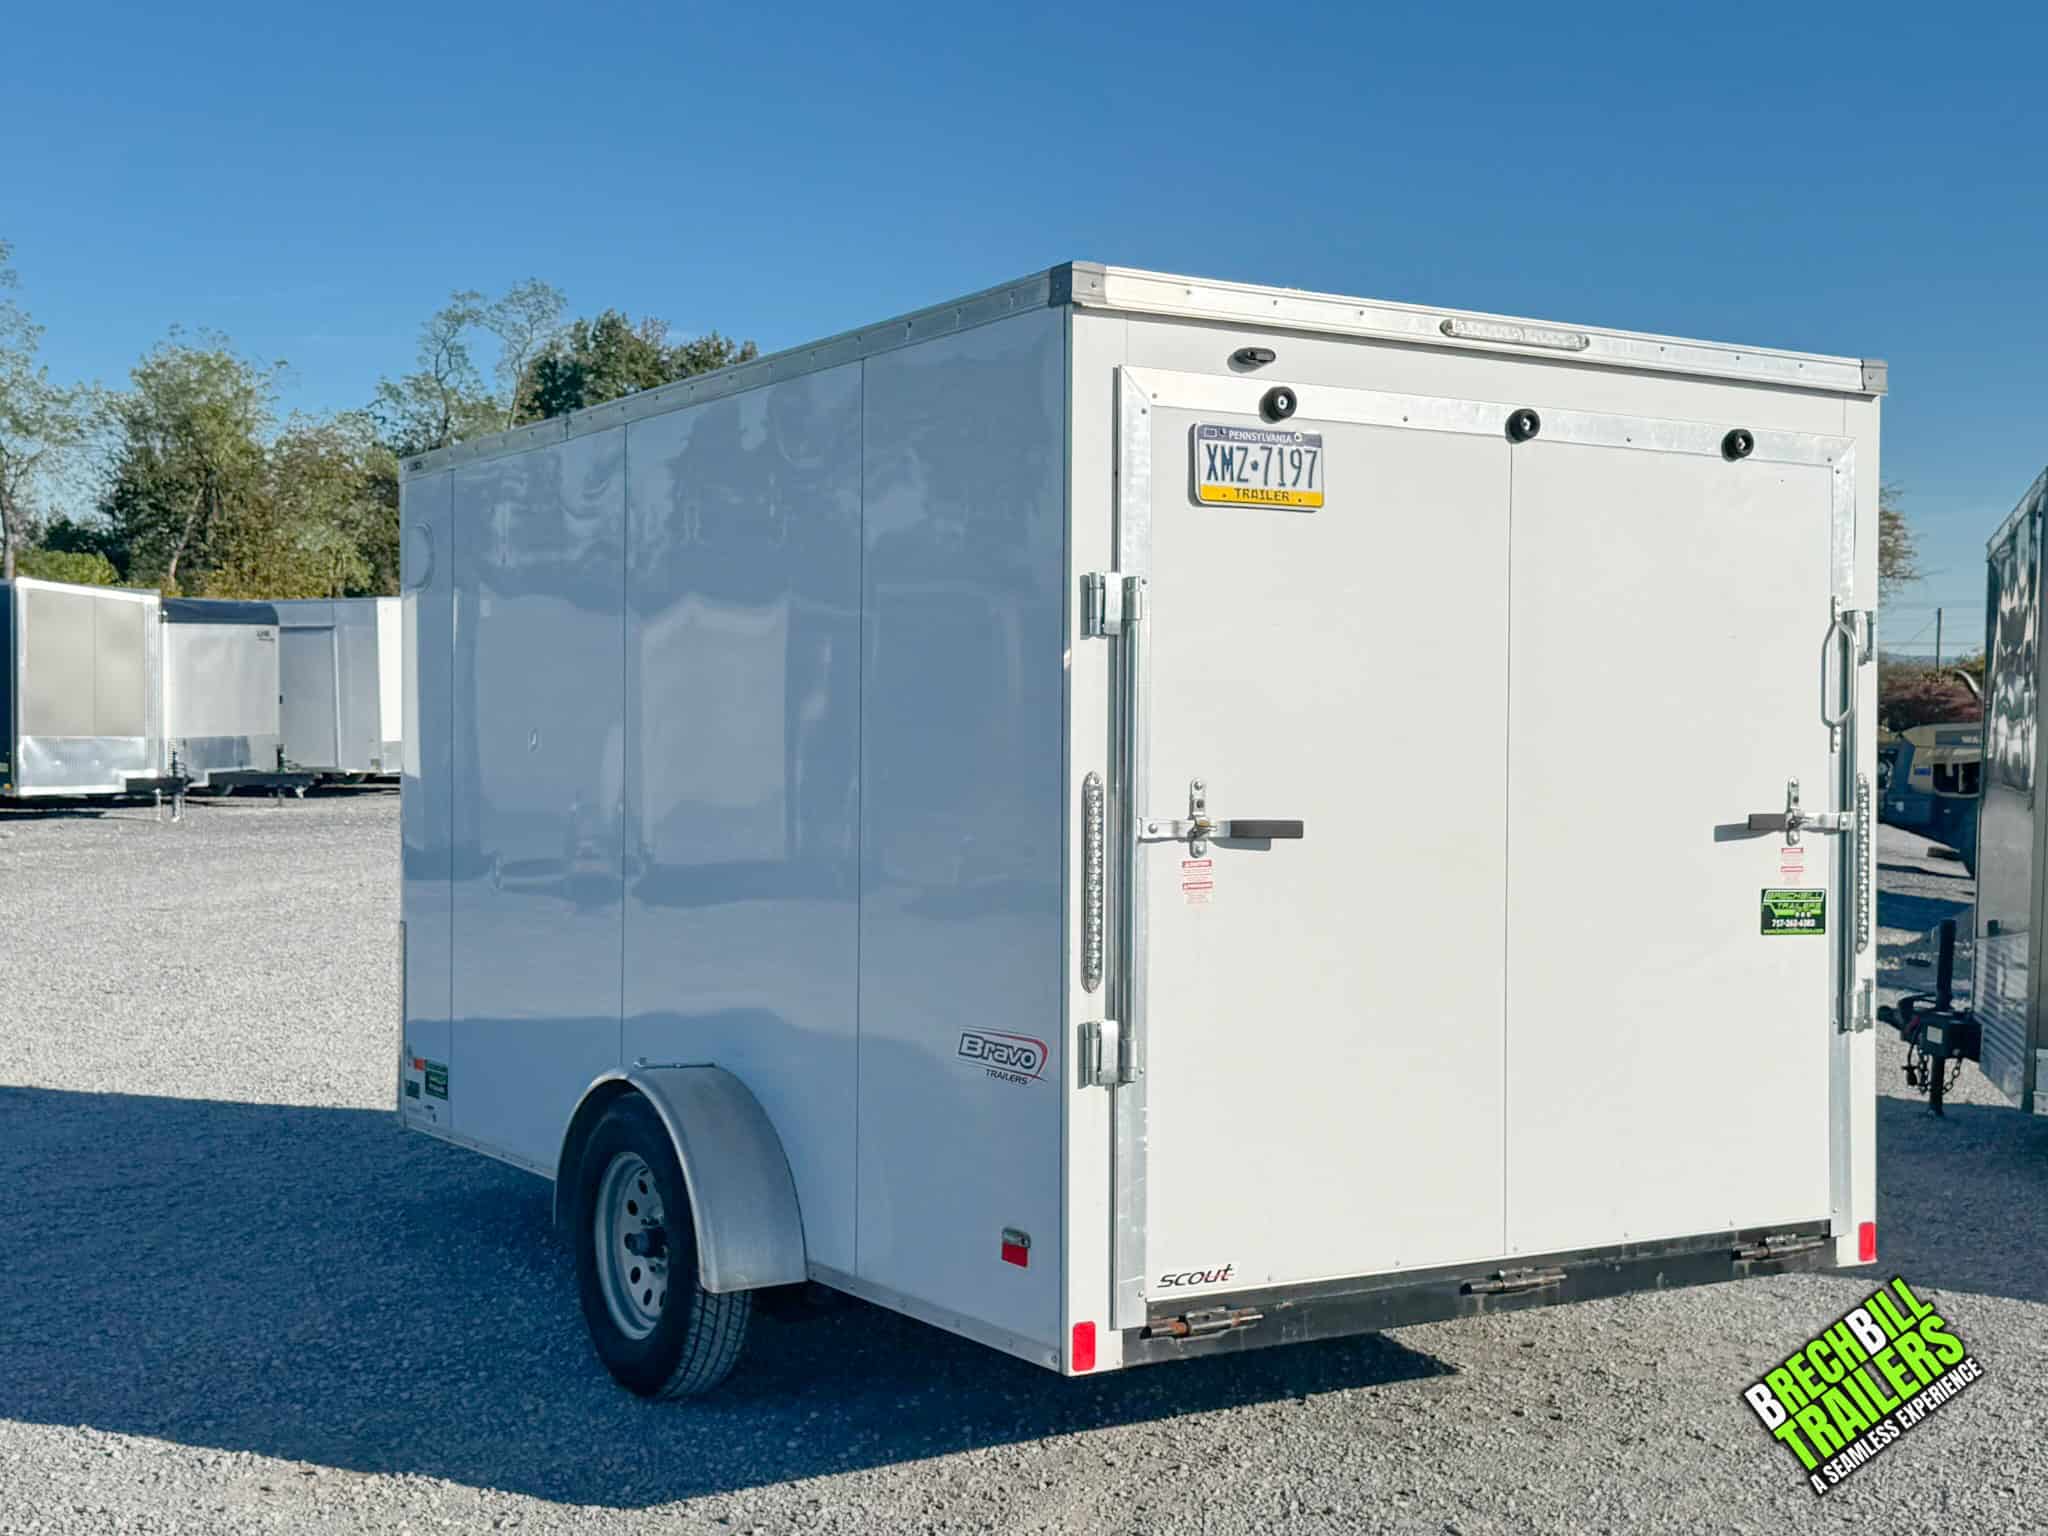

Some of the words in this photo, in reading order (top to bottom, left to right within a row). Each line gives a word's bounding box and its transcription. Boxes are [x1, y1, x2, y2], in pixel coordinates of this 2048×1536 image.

[1229, 430, 1292, 443] PENNSYLVANIA
[1234, 488, 1289, 502] TRAILER
[959, 1032, 1036, 1069] Bravo
[986, 1068, 1027, 1085] TRAILERS
